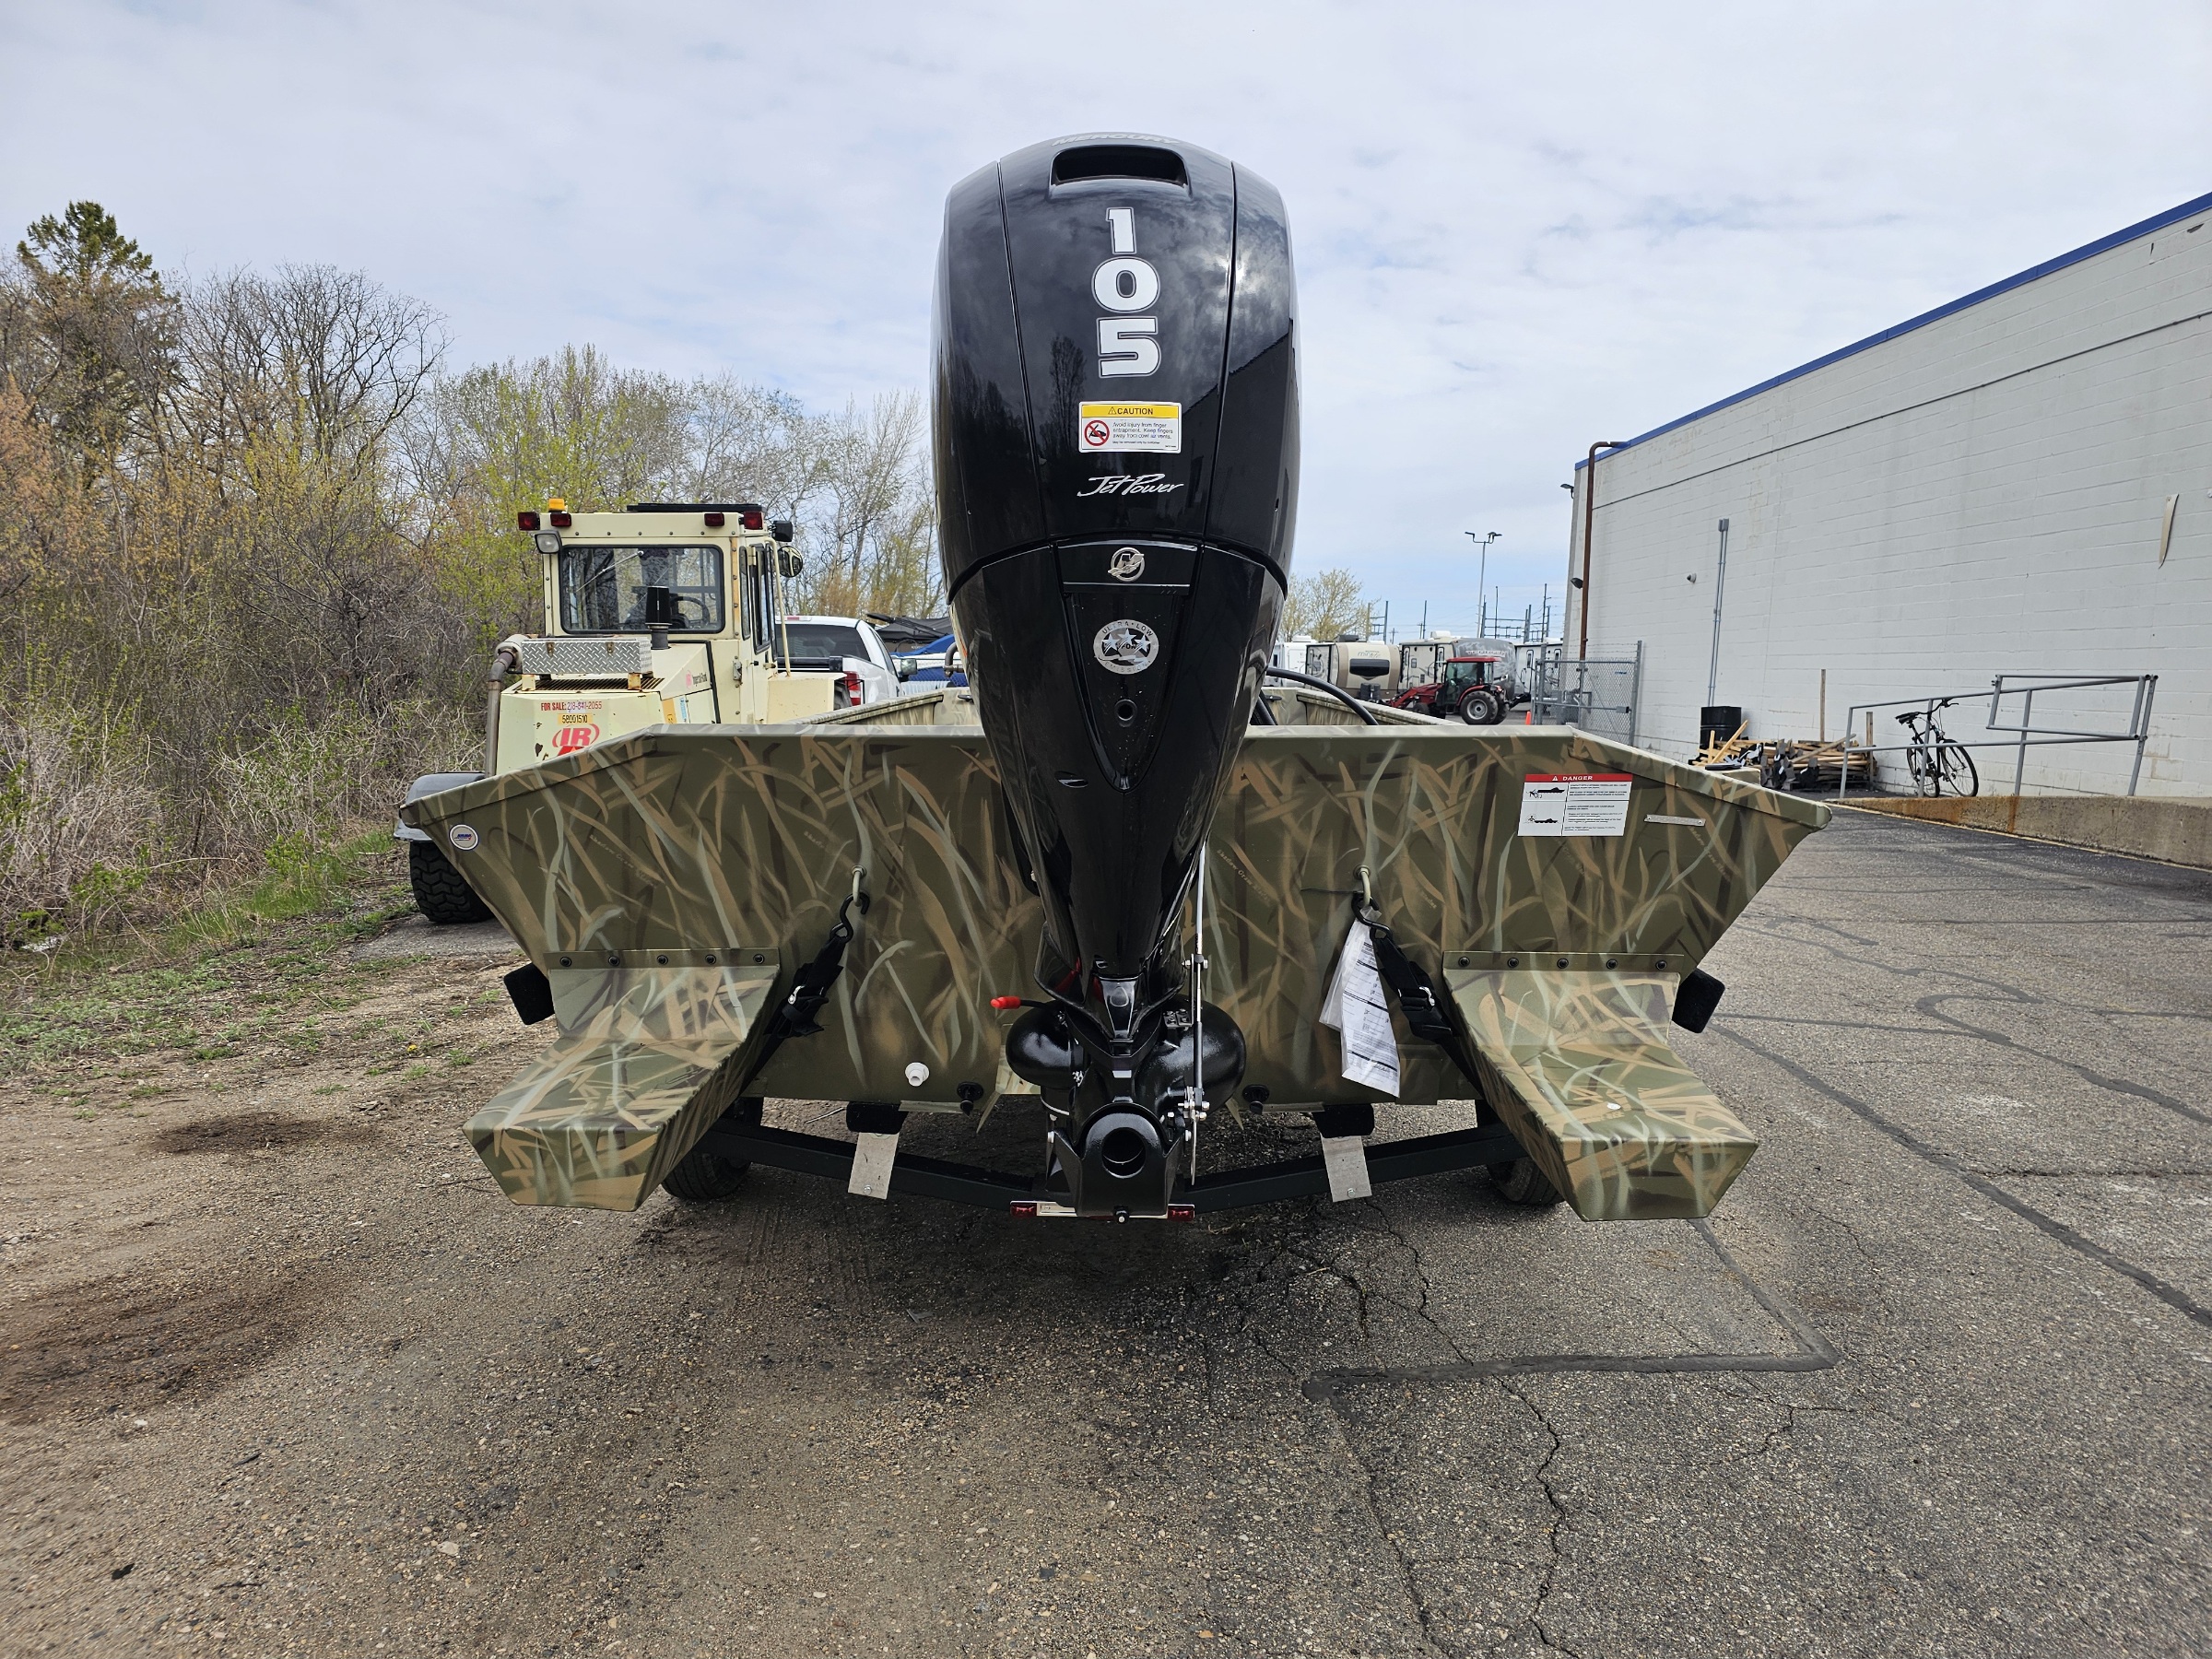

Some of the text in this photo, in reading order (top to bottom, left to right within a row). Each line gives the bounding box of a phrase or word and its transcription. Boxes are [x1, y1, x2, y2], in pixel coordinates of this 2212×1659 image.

[1051, 134, 1181, 147] MERCURY
[1091, 206, 1161, 379] 105
[1116, 407, 1154, 416] CAUTION
[1077, 473, 1184, 498] Jet Power
[1101, 620, 1154, 637] ULTRA LOW
[541, 702, 551, 712] FOR
[551, 701, 567, 711] SALE:
[559, 727, 592, 747] IR
